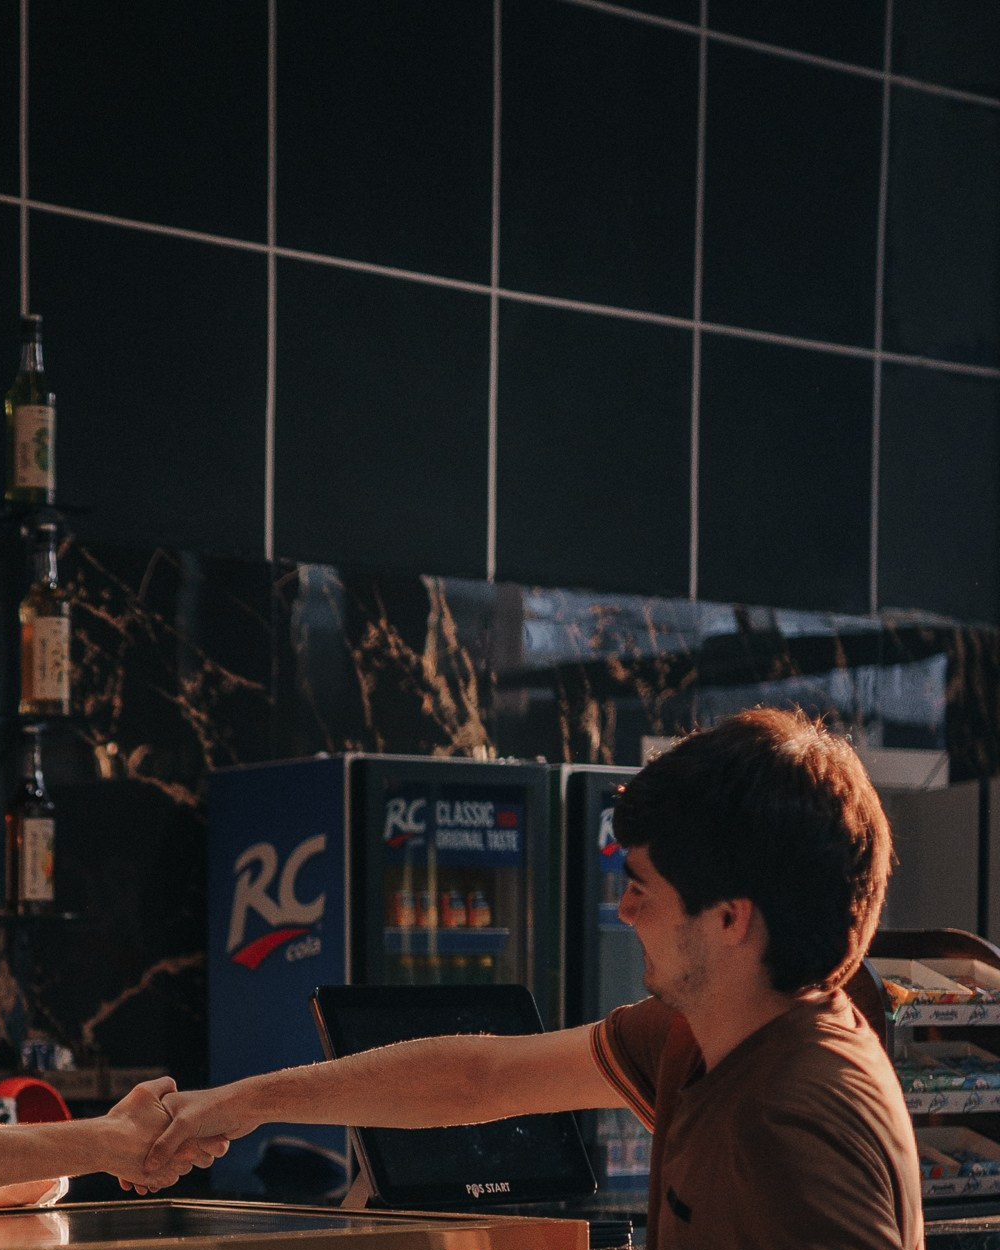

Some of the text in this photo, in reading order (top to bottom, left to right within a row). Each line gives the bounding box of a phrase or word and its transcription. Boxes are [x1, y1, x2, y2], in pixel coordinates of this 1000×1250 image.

[384, 797, 427, 840] RC
[436, 800, 495, 828] CLASSIC
[226, 833, 328, 954] RC
[284, 935, 322, 962] cola
[485, 1181, 511, 1194] START
